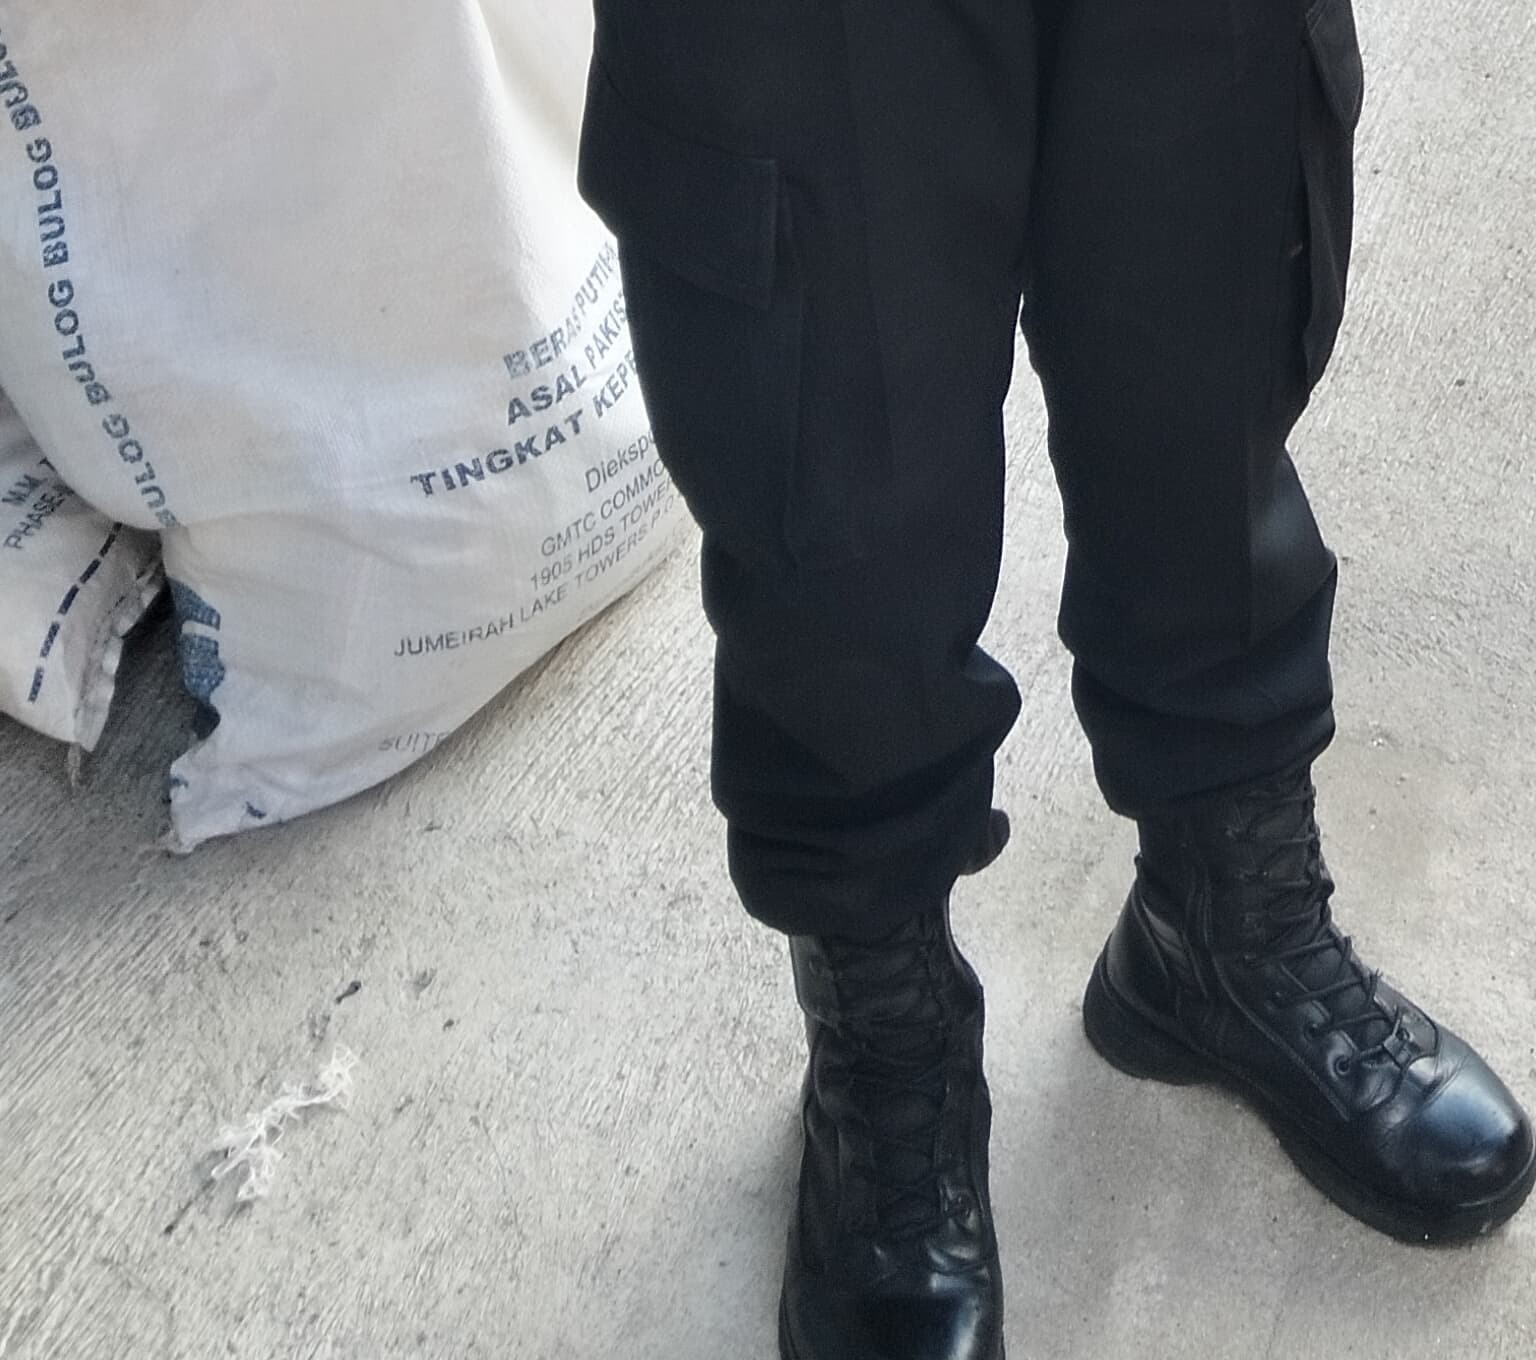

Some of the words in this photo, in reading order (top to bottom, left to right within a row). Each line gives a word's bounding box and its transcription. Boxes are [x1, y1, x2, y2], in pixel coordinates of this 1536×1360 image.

[26, 137, 69, 268] BULOG
[48, 279, 112, 406] BULOG
[102, 413, 180, 530] BULOG
[507, 365, 588, 426] ASAL
[410, 409, 584, 496] TINGKAT
[530, 558, 572, 592] 1905
[578, 526, 615, 564] HDS
[541, 512, 596, 557] GMTC
[394, 614, 514, 658] JUMEIRAH
[520, 587, 568, 623] LAKE
